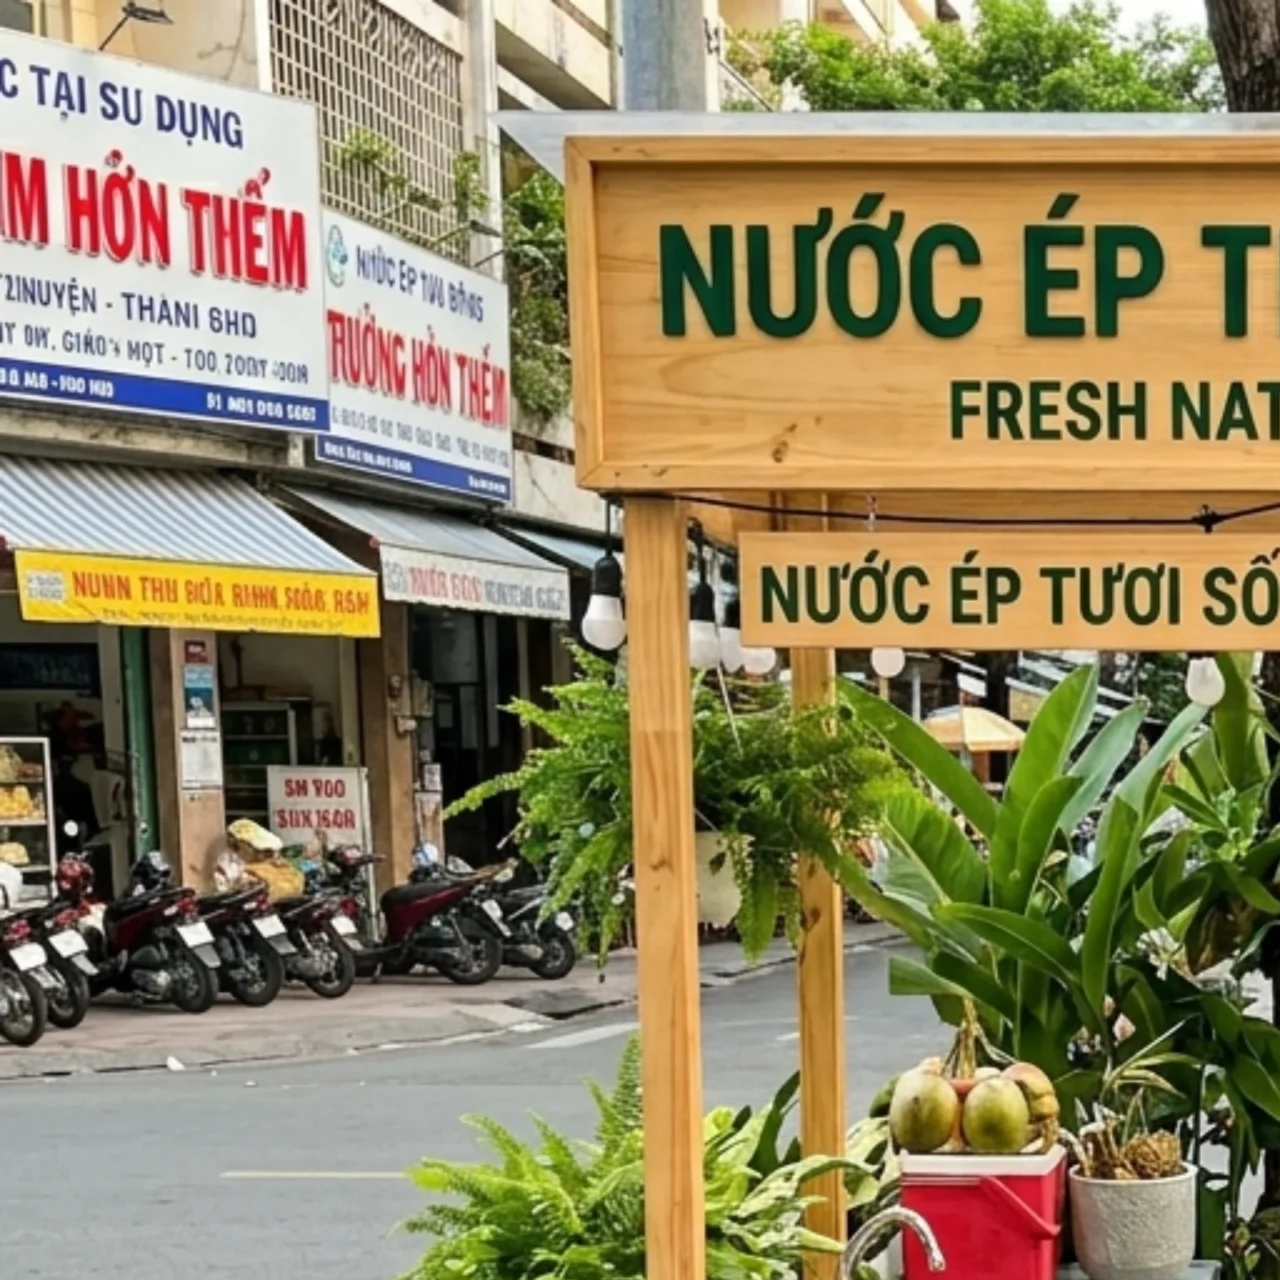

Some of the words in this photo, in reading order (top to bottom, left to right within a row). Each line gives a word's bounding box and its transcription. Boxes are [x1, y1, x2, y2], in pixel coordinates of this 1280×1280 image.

[29, 64, 86, 121] TẠI
[155, 94, 244, 149] DỤNG
[658, 192, 983, 338] NƯỚC
[1023, 193, 1165, 338] ÉP
[950, 381, 1147, 441] FRESH
[759, 548, 930, 625] NƯỚC
[950, 549, 1021, 625] ÉP
[1040, 562, 1180, 625] TƯƠI
